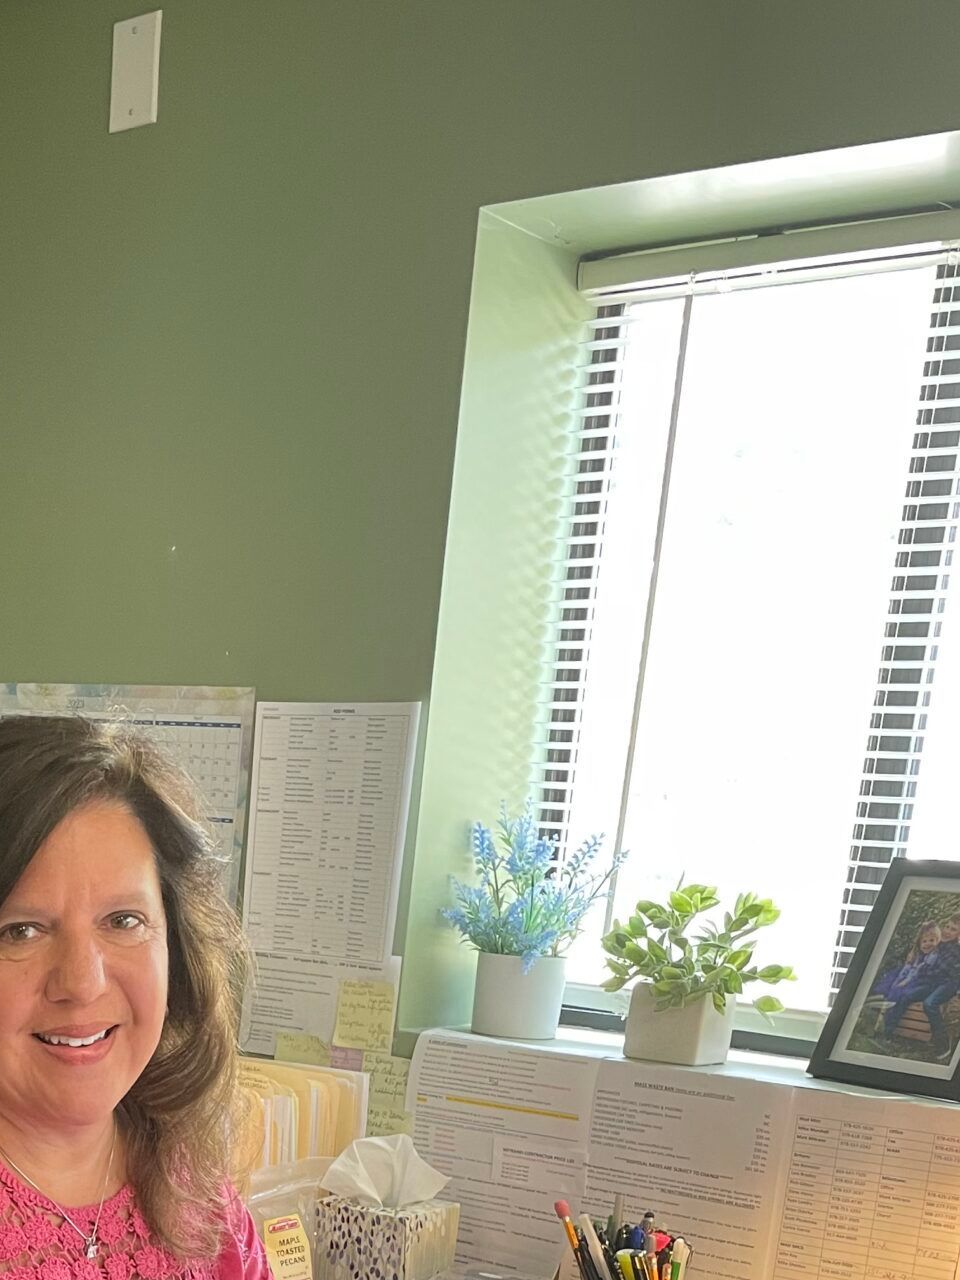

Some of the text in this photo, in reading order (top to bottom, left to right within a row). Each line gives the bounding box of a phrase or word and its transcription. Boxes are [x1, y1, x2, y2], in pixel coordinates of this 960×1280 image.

[279, 1236, 300, 1247] MAPLE
[276, 1245, 305, 1257] TOASTED
[280, 1255, 306, 1267] PECANS
